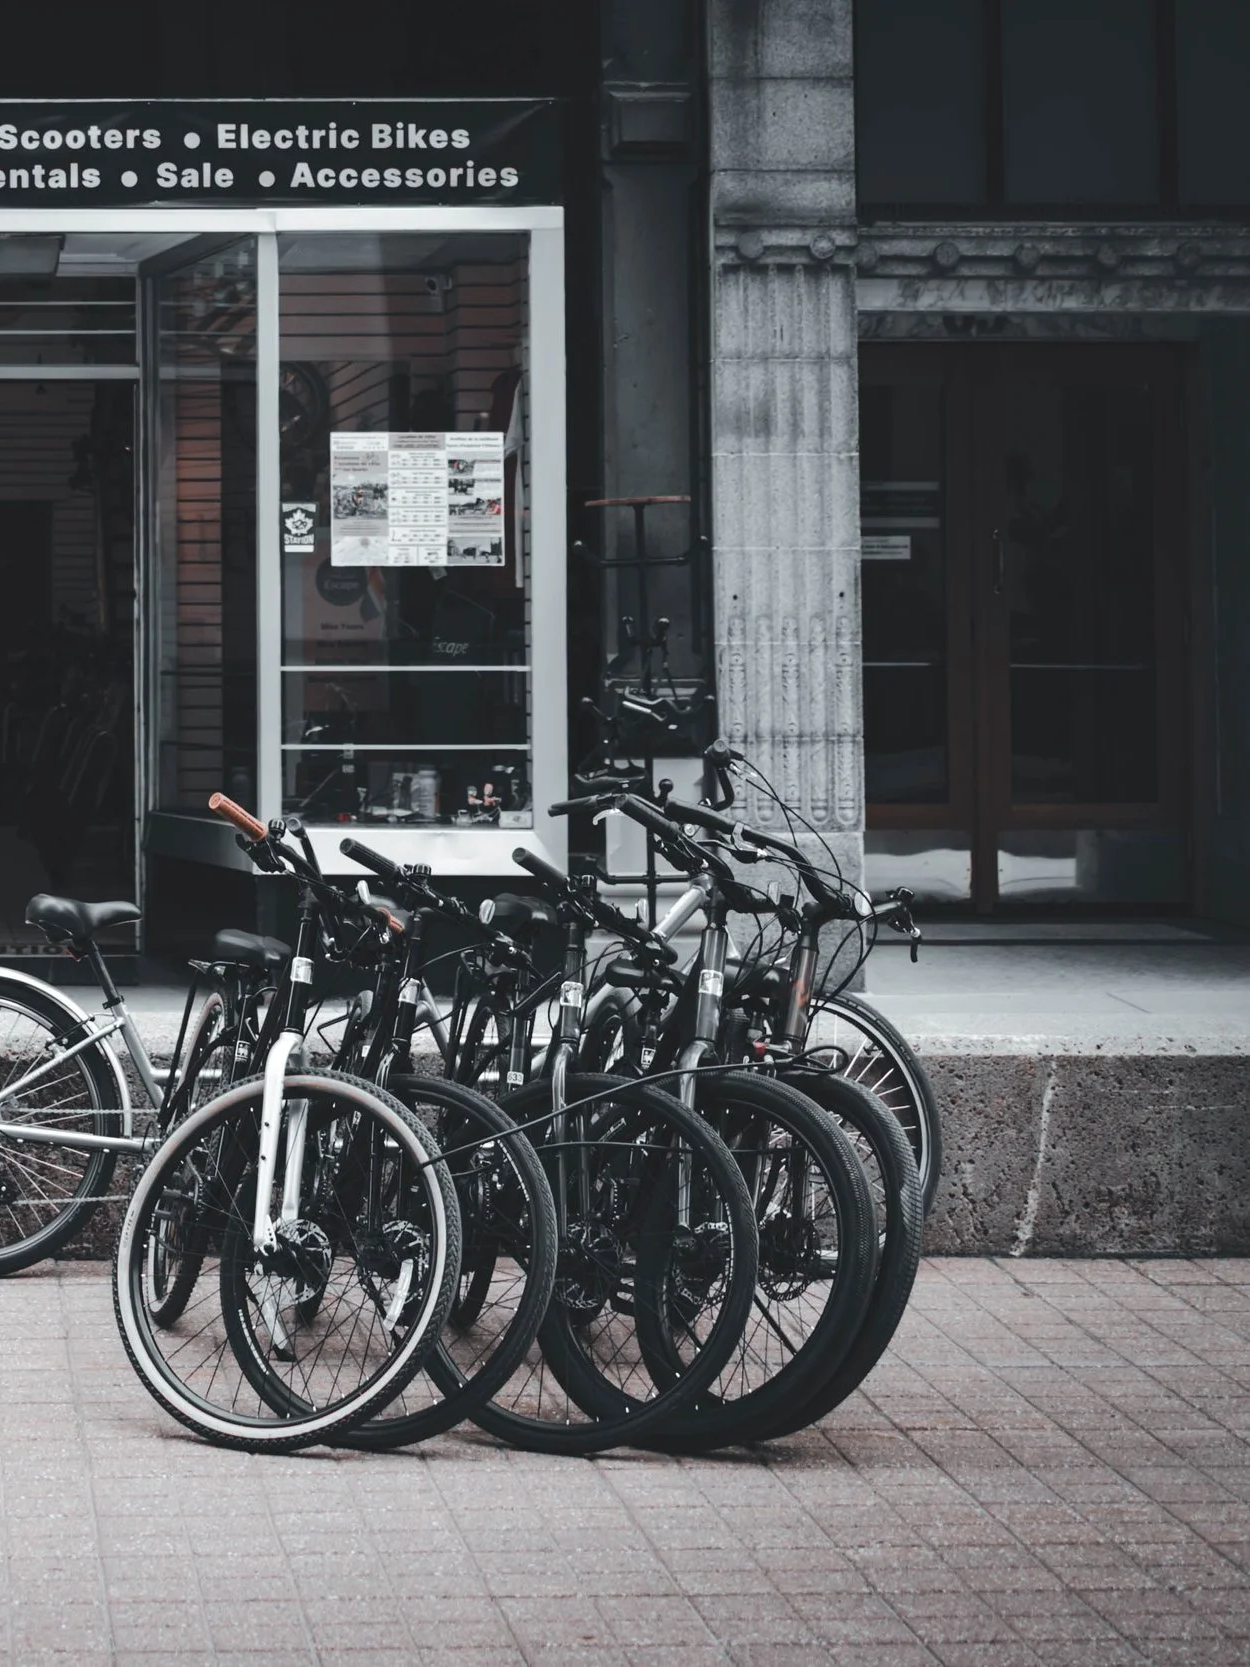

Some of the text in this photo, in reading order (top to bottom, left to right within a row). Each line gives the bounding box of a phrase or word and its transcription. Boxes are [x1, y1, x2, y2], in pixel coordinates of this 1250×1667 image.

[217, 121, 360, 150] Electric
[371, 121, 471, 149] Bikes
[156, 161, 234, 189] Sale
[290, 159, 519, 189] Accessories
